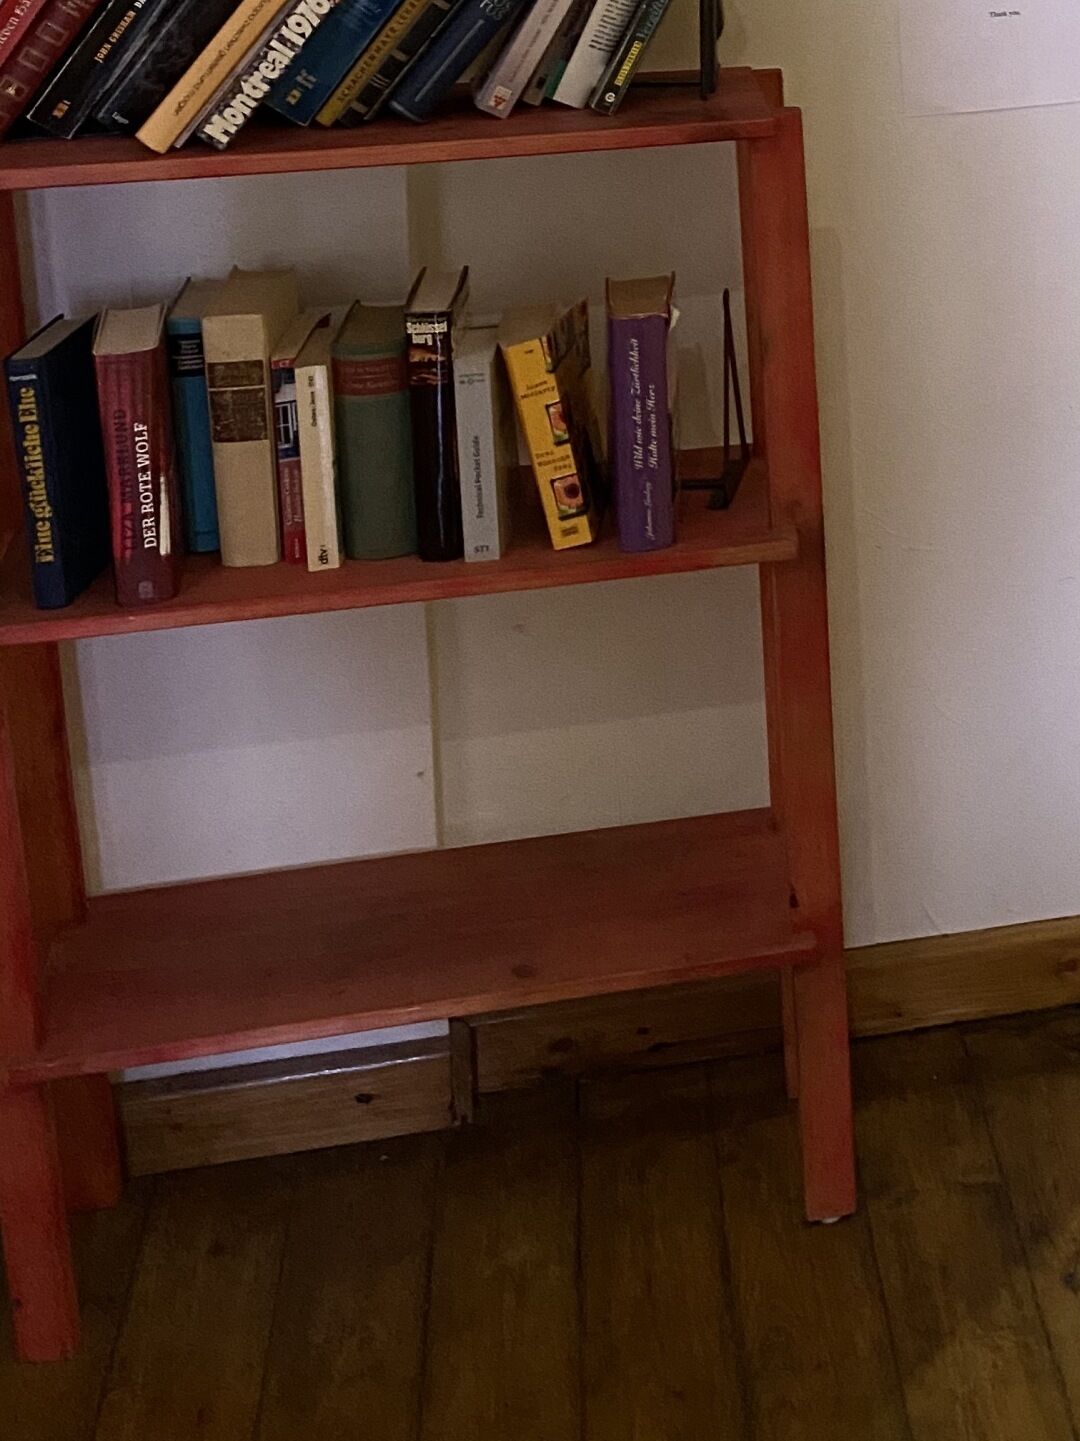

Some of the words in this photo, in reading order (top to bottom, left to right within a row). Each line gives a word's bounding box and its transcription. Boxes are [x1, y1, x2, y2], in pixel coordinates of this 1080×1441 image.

[94, 42, 112, 64] JOHN
[203, 38, 296, 144] Montreal
[15, 385, 37, 423] Ehe
[133, 421, 151, 469] WOLF
[20, 422, 52, 519] glückliche
[137, 470, 155, 515] ROTE
[31, 520, 54, 564] Eine
[142, 516, 158, 550] DER
